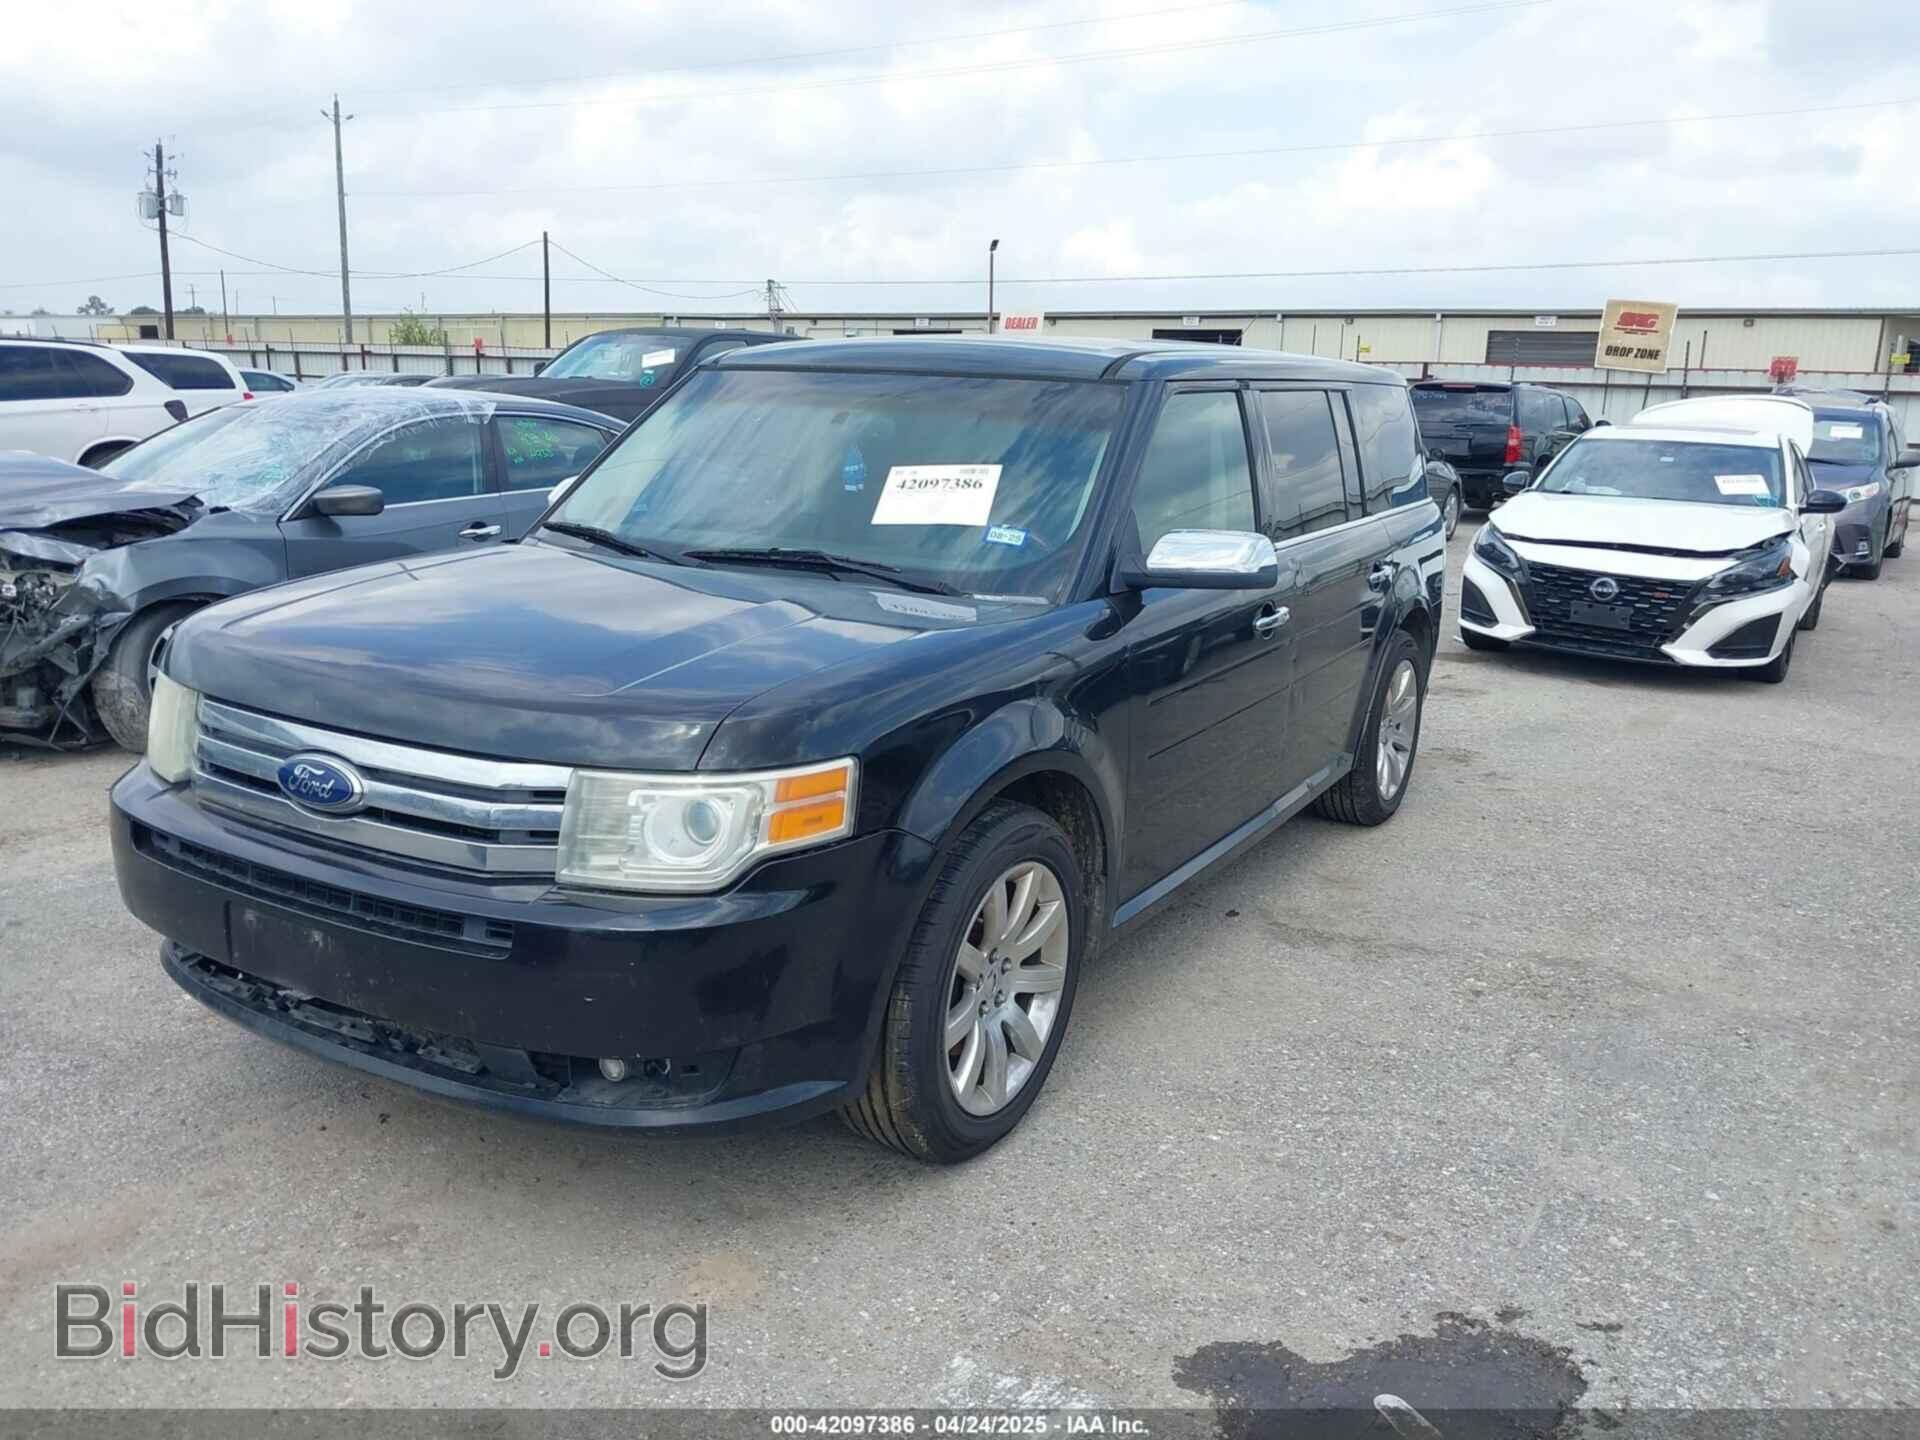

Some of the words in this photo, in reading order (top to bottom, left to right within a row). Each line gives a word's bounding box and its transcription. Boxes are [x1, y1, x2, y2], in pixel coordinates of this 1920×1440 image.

[1004, 316, 1038, 330] DEALER
[1605, 345, 1633, 357] DROP
[1633, 348, 1661, 360] ZONE
[896, 477, 983, 490] 42097386
[288, 764, 334, 798] Ford
